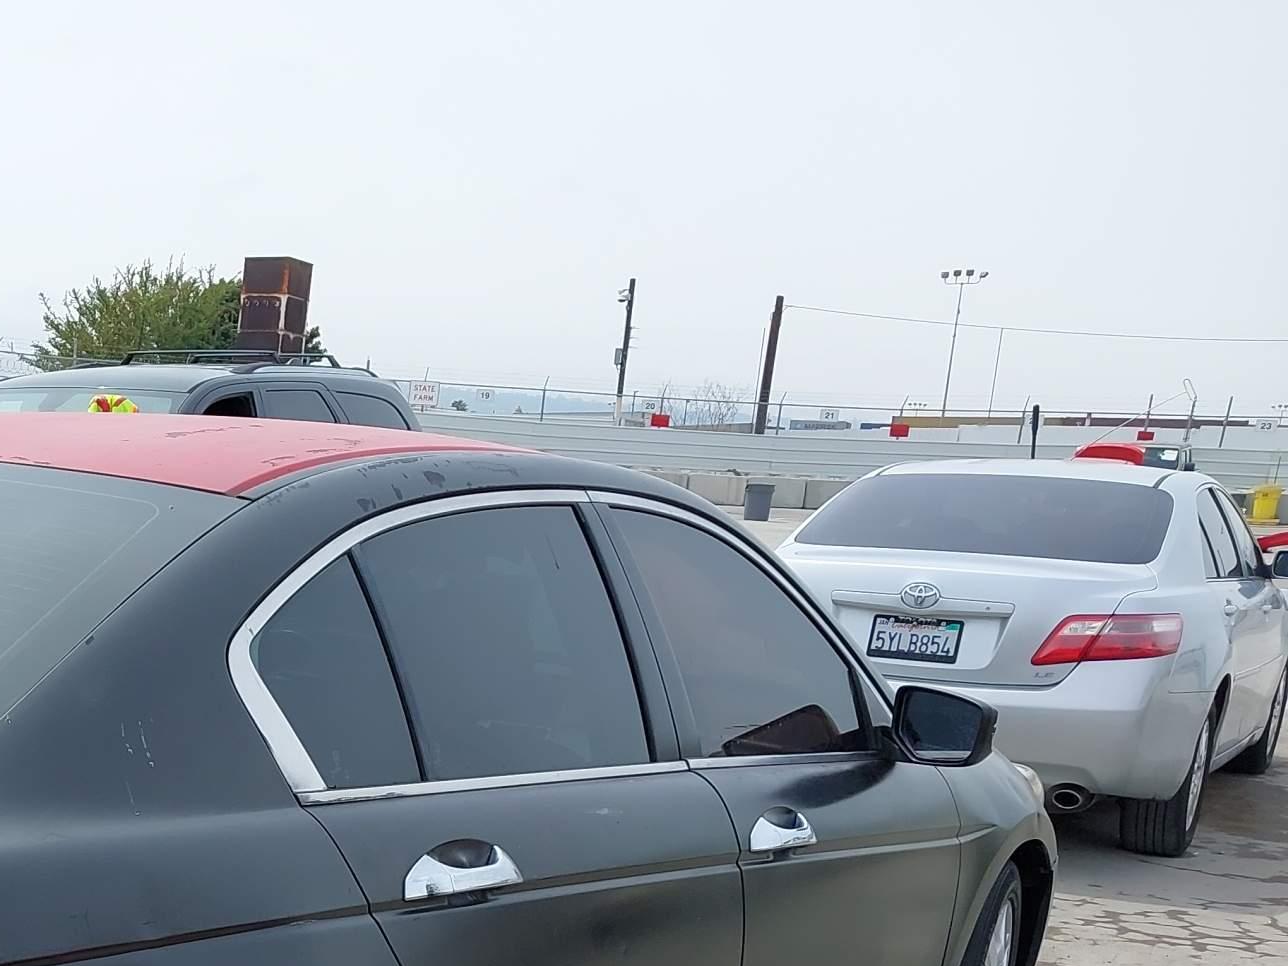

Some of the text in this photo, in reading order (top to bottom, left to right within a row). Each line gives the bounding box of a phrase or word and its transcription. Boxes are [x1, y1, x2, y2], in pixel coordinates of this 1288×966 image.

[414, 384, 437, 393] STATE
[413, 393, 434, 402] FARM
[480, 391, 490, 400] 19
[645, 402, 656, 410] 20
[824, 411, 835, 419] 21
[1260, 422, 1272, 430] 23
[874, 630, 951, 656] 5YLB854
